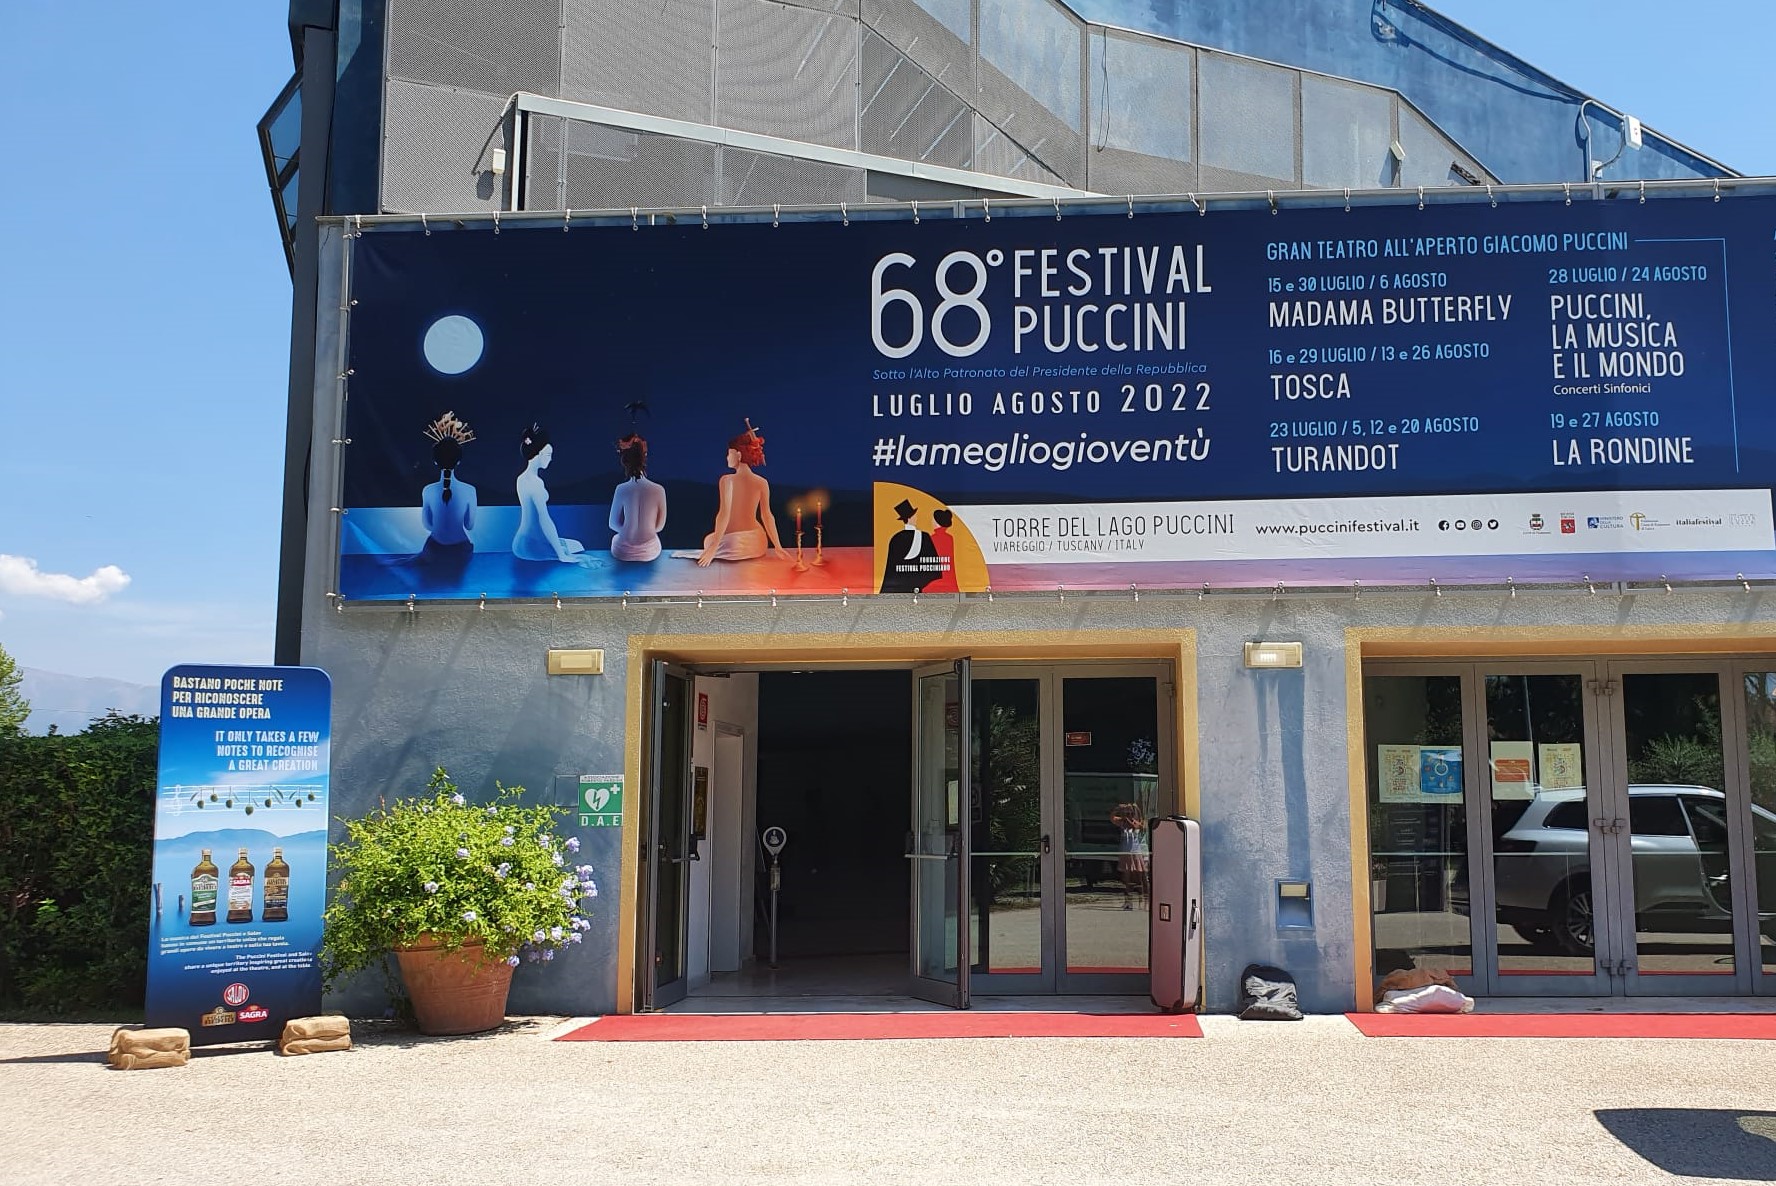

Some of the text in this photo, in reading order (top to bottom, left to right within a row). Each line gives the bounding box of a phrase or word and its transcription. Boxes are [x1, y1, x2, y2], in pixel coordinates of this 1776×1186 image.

[1267, 232, 1627, 260] GRAN TEATRO ALL'APERTO GIACOMO PUCCINI
[1015, 245, 1211, 297] FESTIVAL
[1549, 269, 1568, 283] 28
[1573, 267, 1616, 282] LUGLIO
[1632, 267, 1649, 281] 24
[1654, 266, 1706, 281] AGOSTO
[1269, 278, 1281, 292] 15
[1286, 283, 1294, 291] e
[1299, 277, 1316, 291] 30
[1321, 276, 1364, 291] LUGLIO
[1380, 275, 1388, 289] 6
[1394, 273, 1446, 288] AGOSTO
[872, 249, 1003, 358] 68°
[1270, 295, 1511, 327] MADAMA BUTTERFLY
[1551, 293, 1651, 320] PUCCINI,
[1015, 302, 1185, 353] PUCCINI
[1552, 322, 1677, 349] LA MUSICA
[1269, 350, 1282, 364] 16
[1287, 355, 1295, 363] e
[1300, 349, 1317, 363] 29
[1322, 347, 1366, 362] LUGLIO
[1382, 346, 1394, 360] 13
[1399, 351, 1407, 360] e
[1413, 345, 1430, 360] 26
[1436, 343, 1489, 359] AGOSTO
[873, 362, 1206, 379] Sotto l'Alto Patronato del Presidente della Repubblica
[1554, 352, 1683, 378] E IL MONDO
[1271, 373, 1350, 400] TOSCA
[1554, 383, 1650, 395] Concerti Sinfonici
[874, 383, 1210, 416] LUGLIO AGOSTO 2022
[1271, 423, 1288, 437] 23
[1293, 421, 1336, 437] LUGLIO
[1353, 420, 1365, 436] 5,
[1371, 420, 1383, 434] 12
[1389, 425, 1396, 433] e
[1402, 419, 1419, 433] 20
[1425, 417, 1478, 433] AGOSTO
[1551, 412, 1658, 428] 19 e 27 AGOSTO
[873, 428, 1210, 471] #lamegliogioventù
[1272, 444, 1398, 472] TURANDOT
[1553, 437, 1694, 465] LA RONDINE
[992, 514, 1233, 537] TORRE DEL LAGO PUCCINI
[1256, 519, 1419, 536] www.puccinifestival.it
[994, 541, 1044, 552] VIAREGGIO
[1057, 540, 1103, 551] TUSCANY
[1116, 539, 1144, 550] ITALY
[920, 564, 950, 572] PUCCINIANO
[174, 676, 283, 691] BASTANO POCHE NOTE
[173, 691, 263, 704] PER RICONOSCERE
[172, 706, 270, 719] UNA GRANDE OPERA
[216, 731, 319, 742] IT ONLY TAKES A FEW
[217, 745, 319, 757] NOTES TO RECOGNISE
[228, 760, 317, 771] A GREAT CREATION
[240, 1011, 267, 1019] SAGRA
